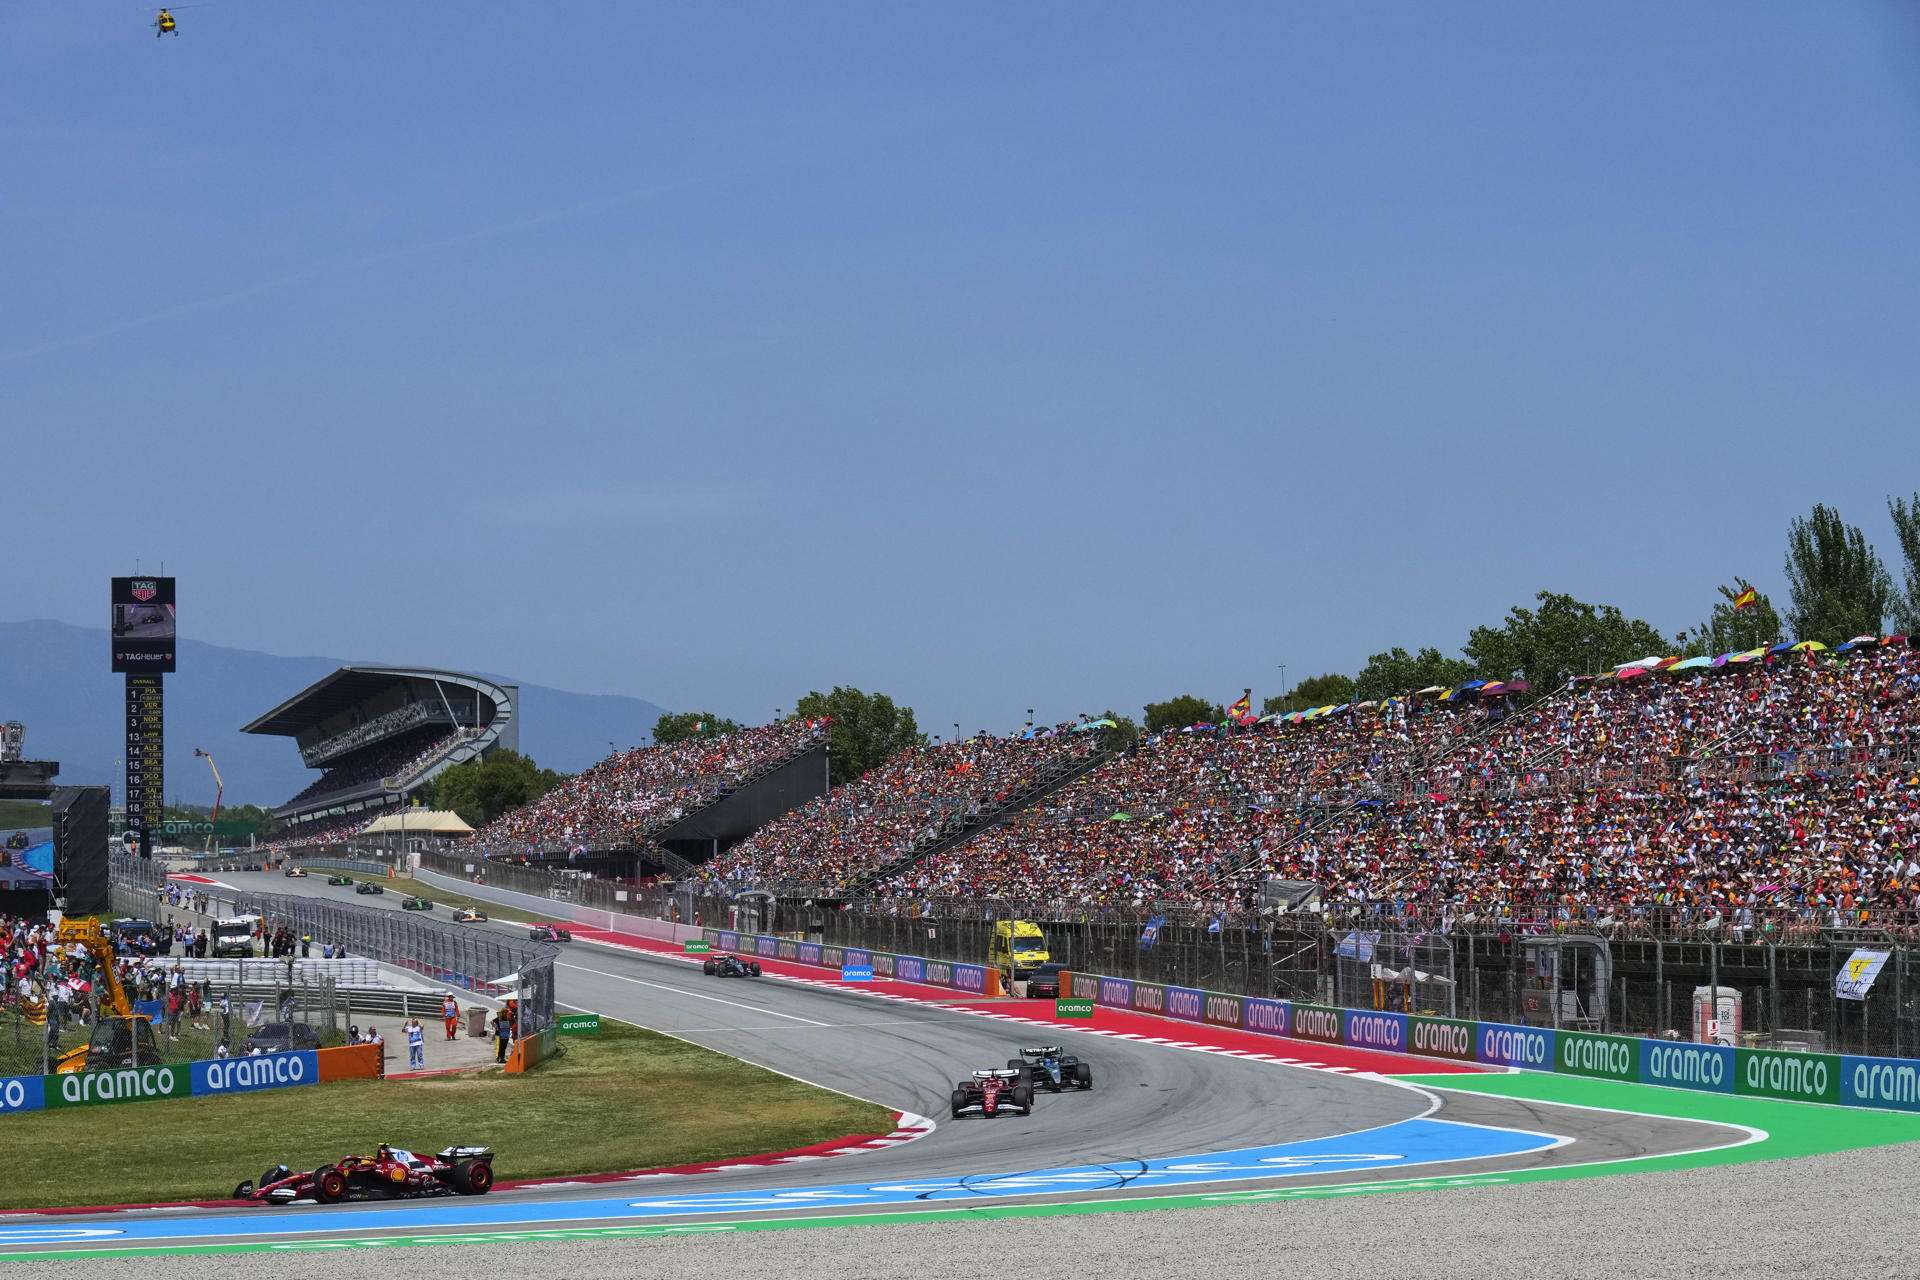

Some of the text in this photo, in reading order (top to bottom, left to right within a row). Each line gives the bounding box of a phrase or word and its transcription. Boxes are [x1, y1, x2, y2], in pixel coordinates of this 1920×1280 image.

[131, 690, 136, 698] 1
[131, 704, 137, 712] 2
[131, 718, 137, 726] 3
[129, 733, 139, 741] 13
[129, 747, 139, 755] 14
[129, 761, 140, 769] 15
[129, 775, 140, 783] 16
[129, 790, 139, 798] 17
[129, 804, 140, 812] 18
[129, 818, 140, 826] 19
[163, 822, 214, 834] amco
[823, 949, 842, 965] aramco
[873, 955, 893, 975] aramco
[844, 969, 871, 977] aramco
[899, 960, 921, 979] aramco
[927, 964, 950, 983] aramco
[956, 968, 981, 989] aramco
[1073, 977, 1098, 999] aramco
[1103, 981, 1129, 1005] aramco
[1058, 1004, 1092, 1012] aramco
[1135, 986, 1163, 1011] aramco
[1170, 991, 1199, 1016] aramco
[1207, 997, 1239, 1024] aramco
[1248, 1003, 1285, 1031] aramco
[562, 1021, 598, 1029] aramco
[1296, 1009, 1338, 1039] aramco
[1352, 1015, 1399, 1046] aramco
[1414, 1022, 1468, 1055] aramco
[1485, 1029, 1545, 1064] aramco
[1564, 1037, 1629, 1075] aramco
[1650, 1046, 1723, 1086] aramco
[207, 1055, 304, 1089] aramco
[1747, 1055, 1828, 1096] aramco
[62, 1067, 174, 1102] aramco
[1854, 1064, 1920, 1102] aram
